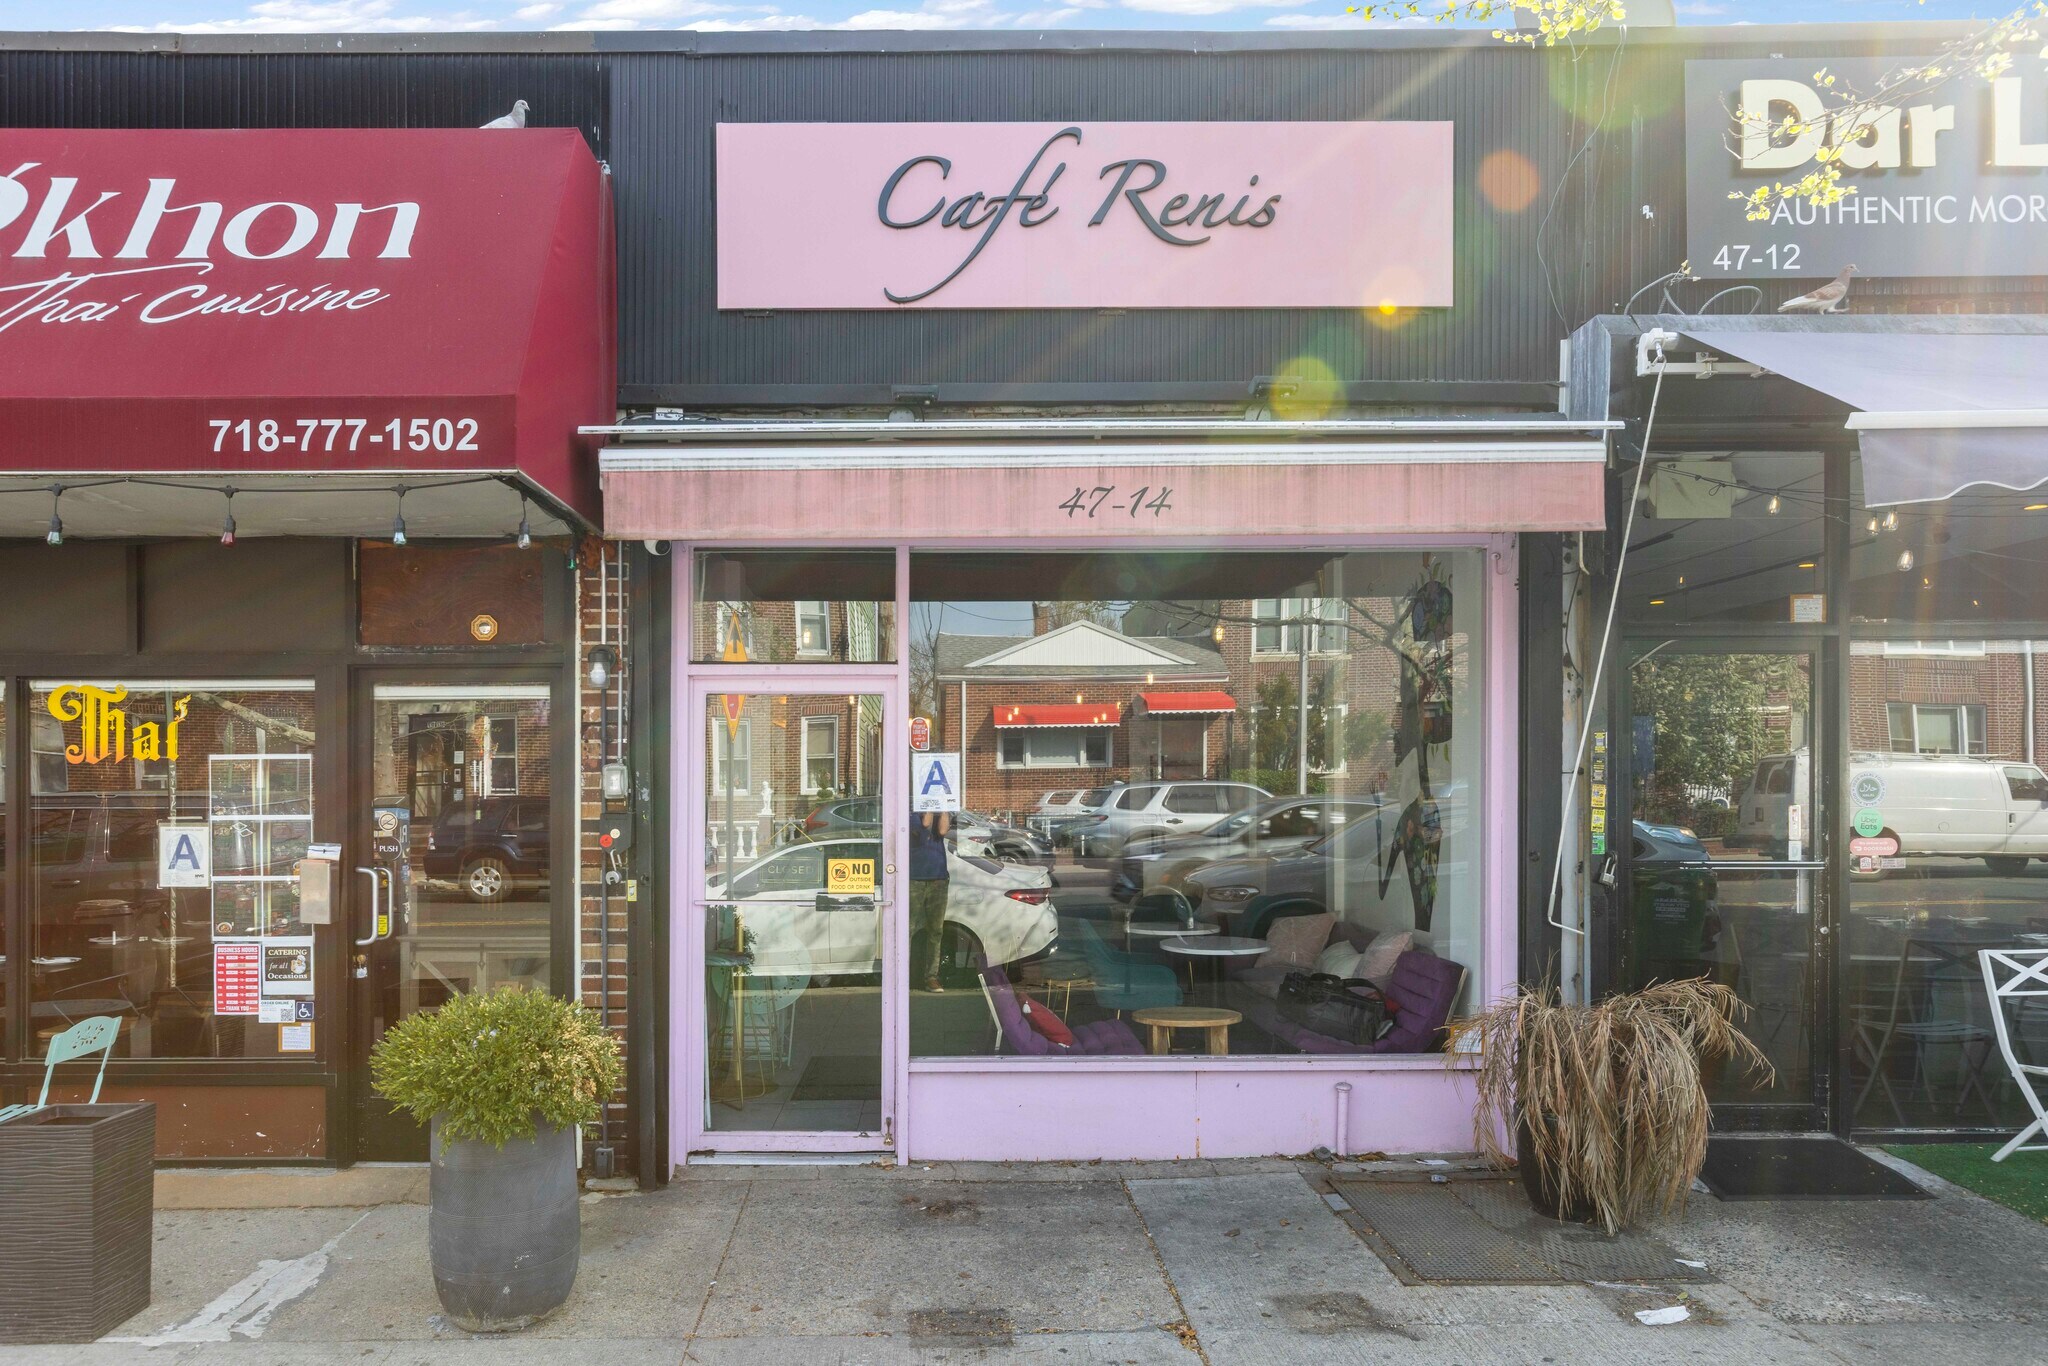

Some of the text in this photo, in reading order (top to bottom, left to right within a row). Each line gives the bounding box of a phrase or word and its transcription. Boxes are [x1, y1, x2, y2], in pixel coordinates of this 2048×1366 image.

[1740, 79, 1954, 169] Dar
[878, 126, 1282, 304] Café Renis
[1770, 194, 1958, 226] AUTHENTIC
[1712, 243, 1801, 271] 47-12
[140, 284, 390, 324] Cuisine
[208, 418, 479, 452] 718-777-1502
[1058, 486, 1173, 519] 47-14
[47, 684, 191, 764] Thai
[921, 760, 952, 795] A
[168, 834, 201, 870] A
[852, 863, 871, 875] NO
[269, 963, 278, 971] for
